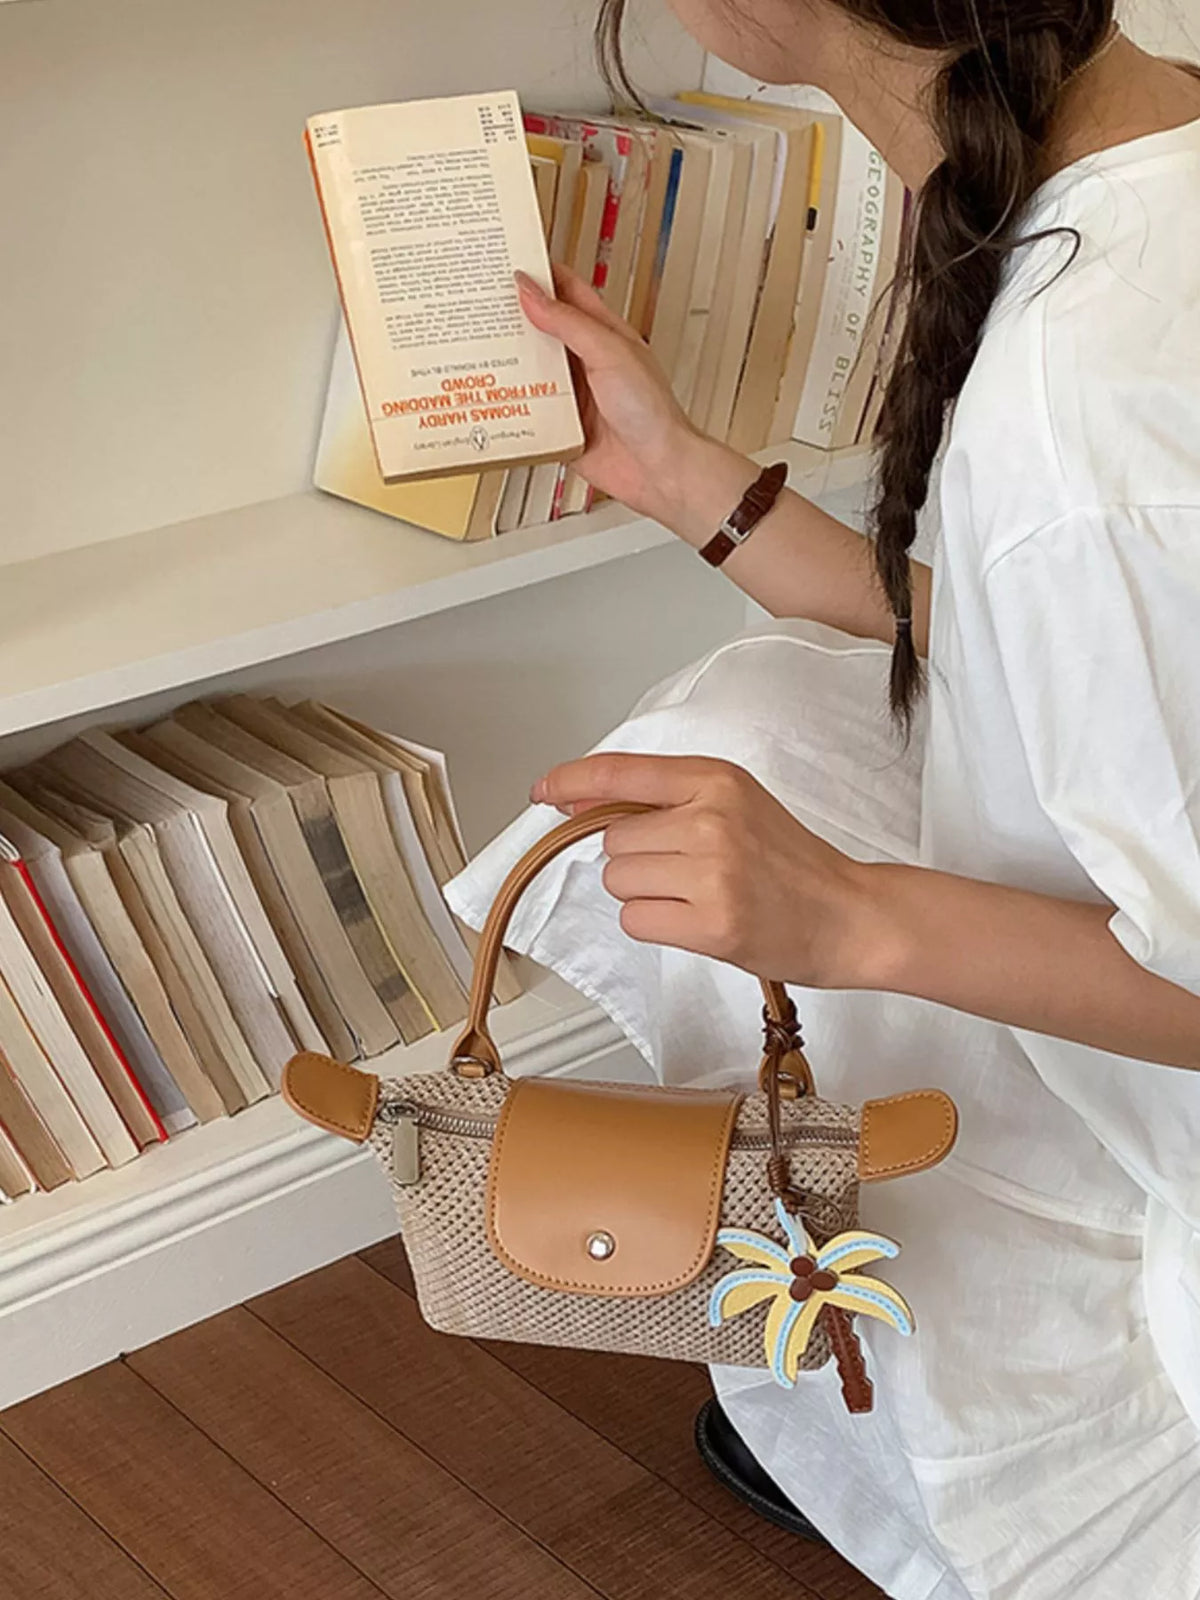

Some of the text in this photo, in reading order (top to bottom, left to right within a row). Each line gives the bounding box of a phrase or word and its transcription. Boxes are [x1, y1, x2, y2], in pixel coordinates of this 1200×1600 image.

[852, 150, 882, 297] GEOGRAPHY
[845, 313, 861, 342] OF
[444, 363, 477, 374] RONALD
[479, 361, 490, 369] BY
[491, 358, 519, 368] EDITED
[441, 373, 496, 392] CROWD
[818, 356, 850, 432] BLISS
[381, 382, 557, 417] FAR FROM THE MADDING
[418, 403, 531, 429] THOMAS HARDY
